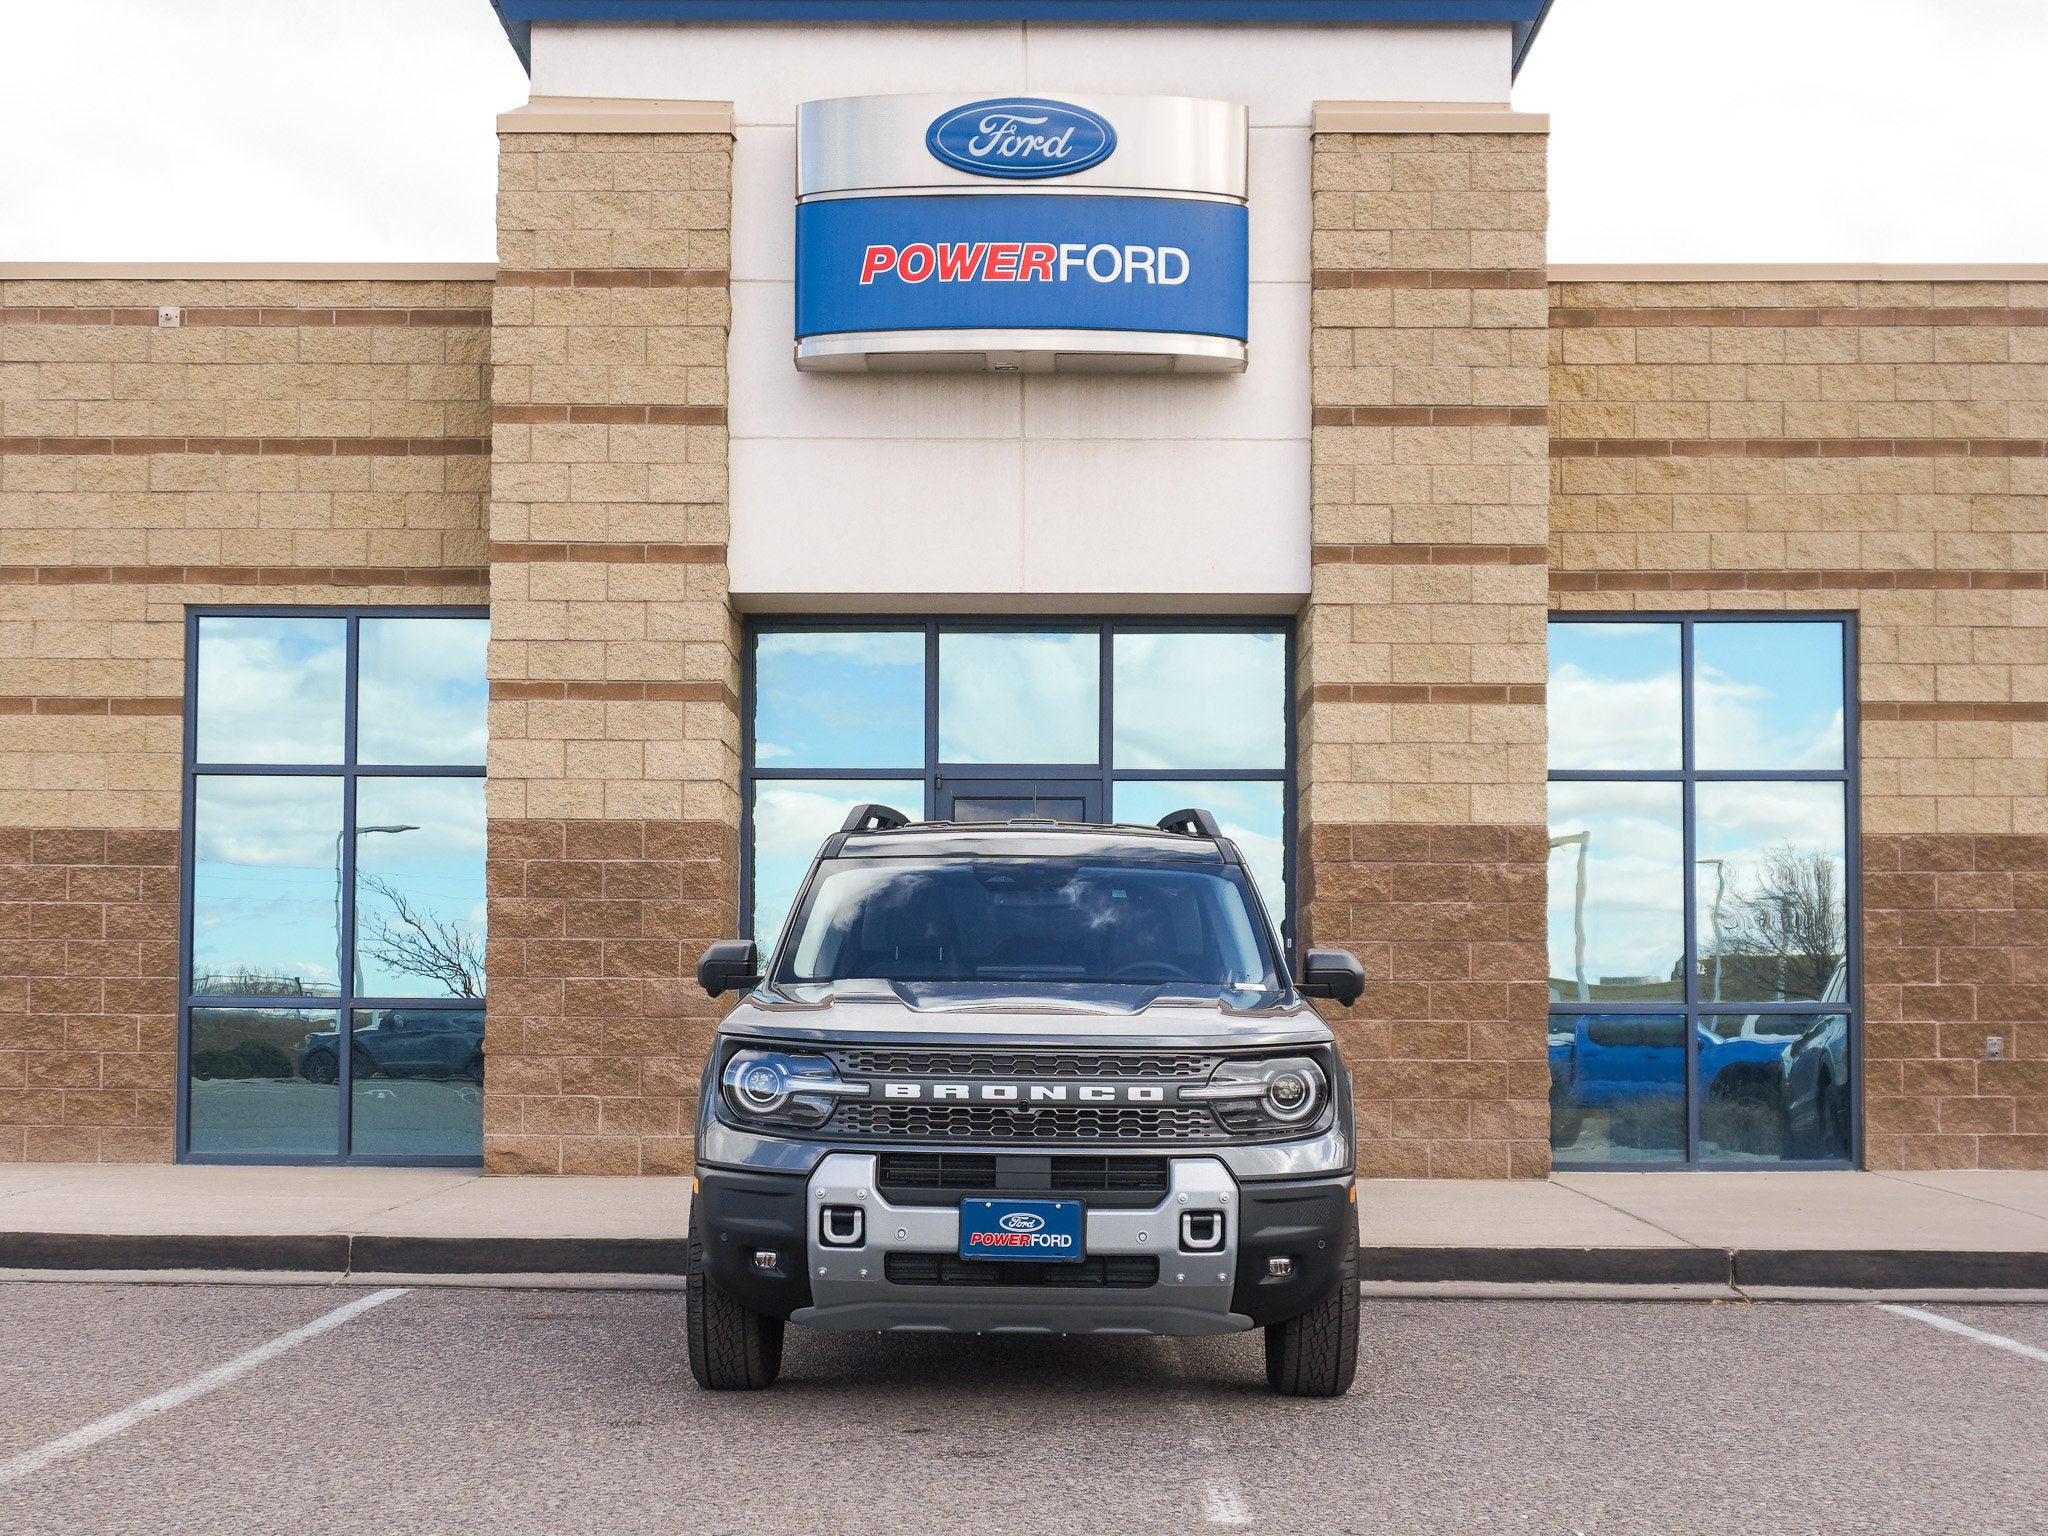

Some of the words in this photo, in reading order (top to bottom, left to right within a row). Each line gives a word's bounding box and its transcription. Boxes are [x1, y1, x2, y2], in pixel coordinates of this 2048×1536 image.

[968, 114, 1073, 158] Ford
[885, 1083, 1164, 1101] BRONCO
[1008, 1217, 1035, 1228] Ford
